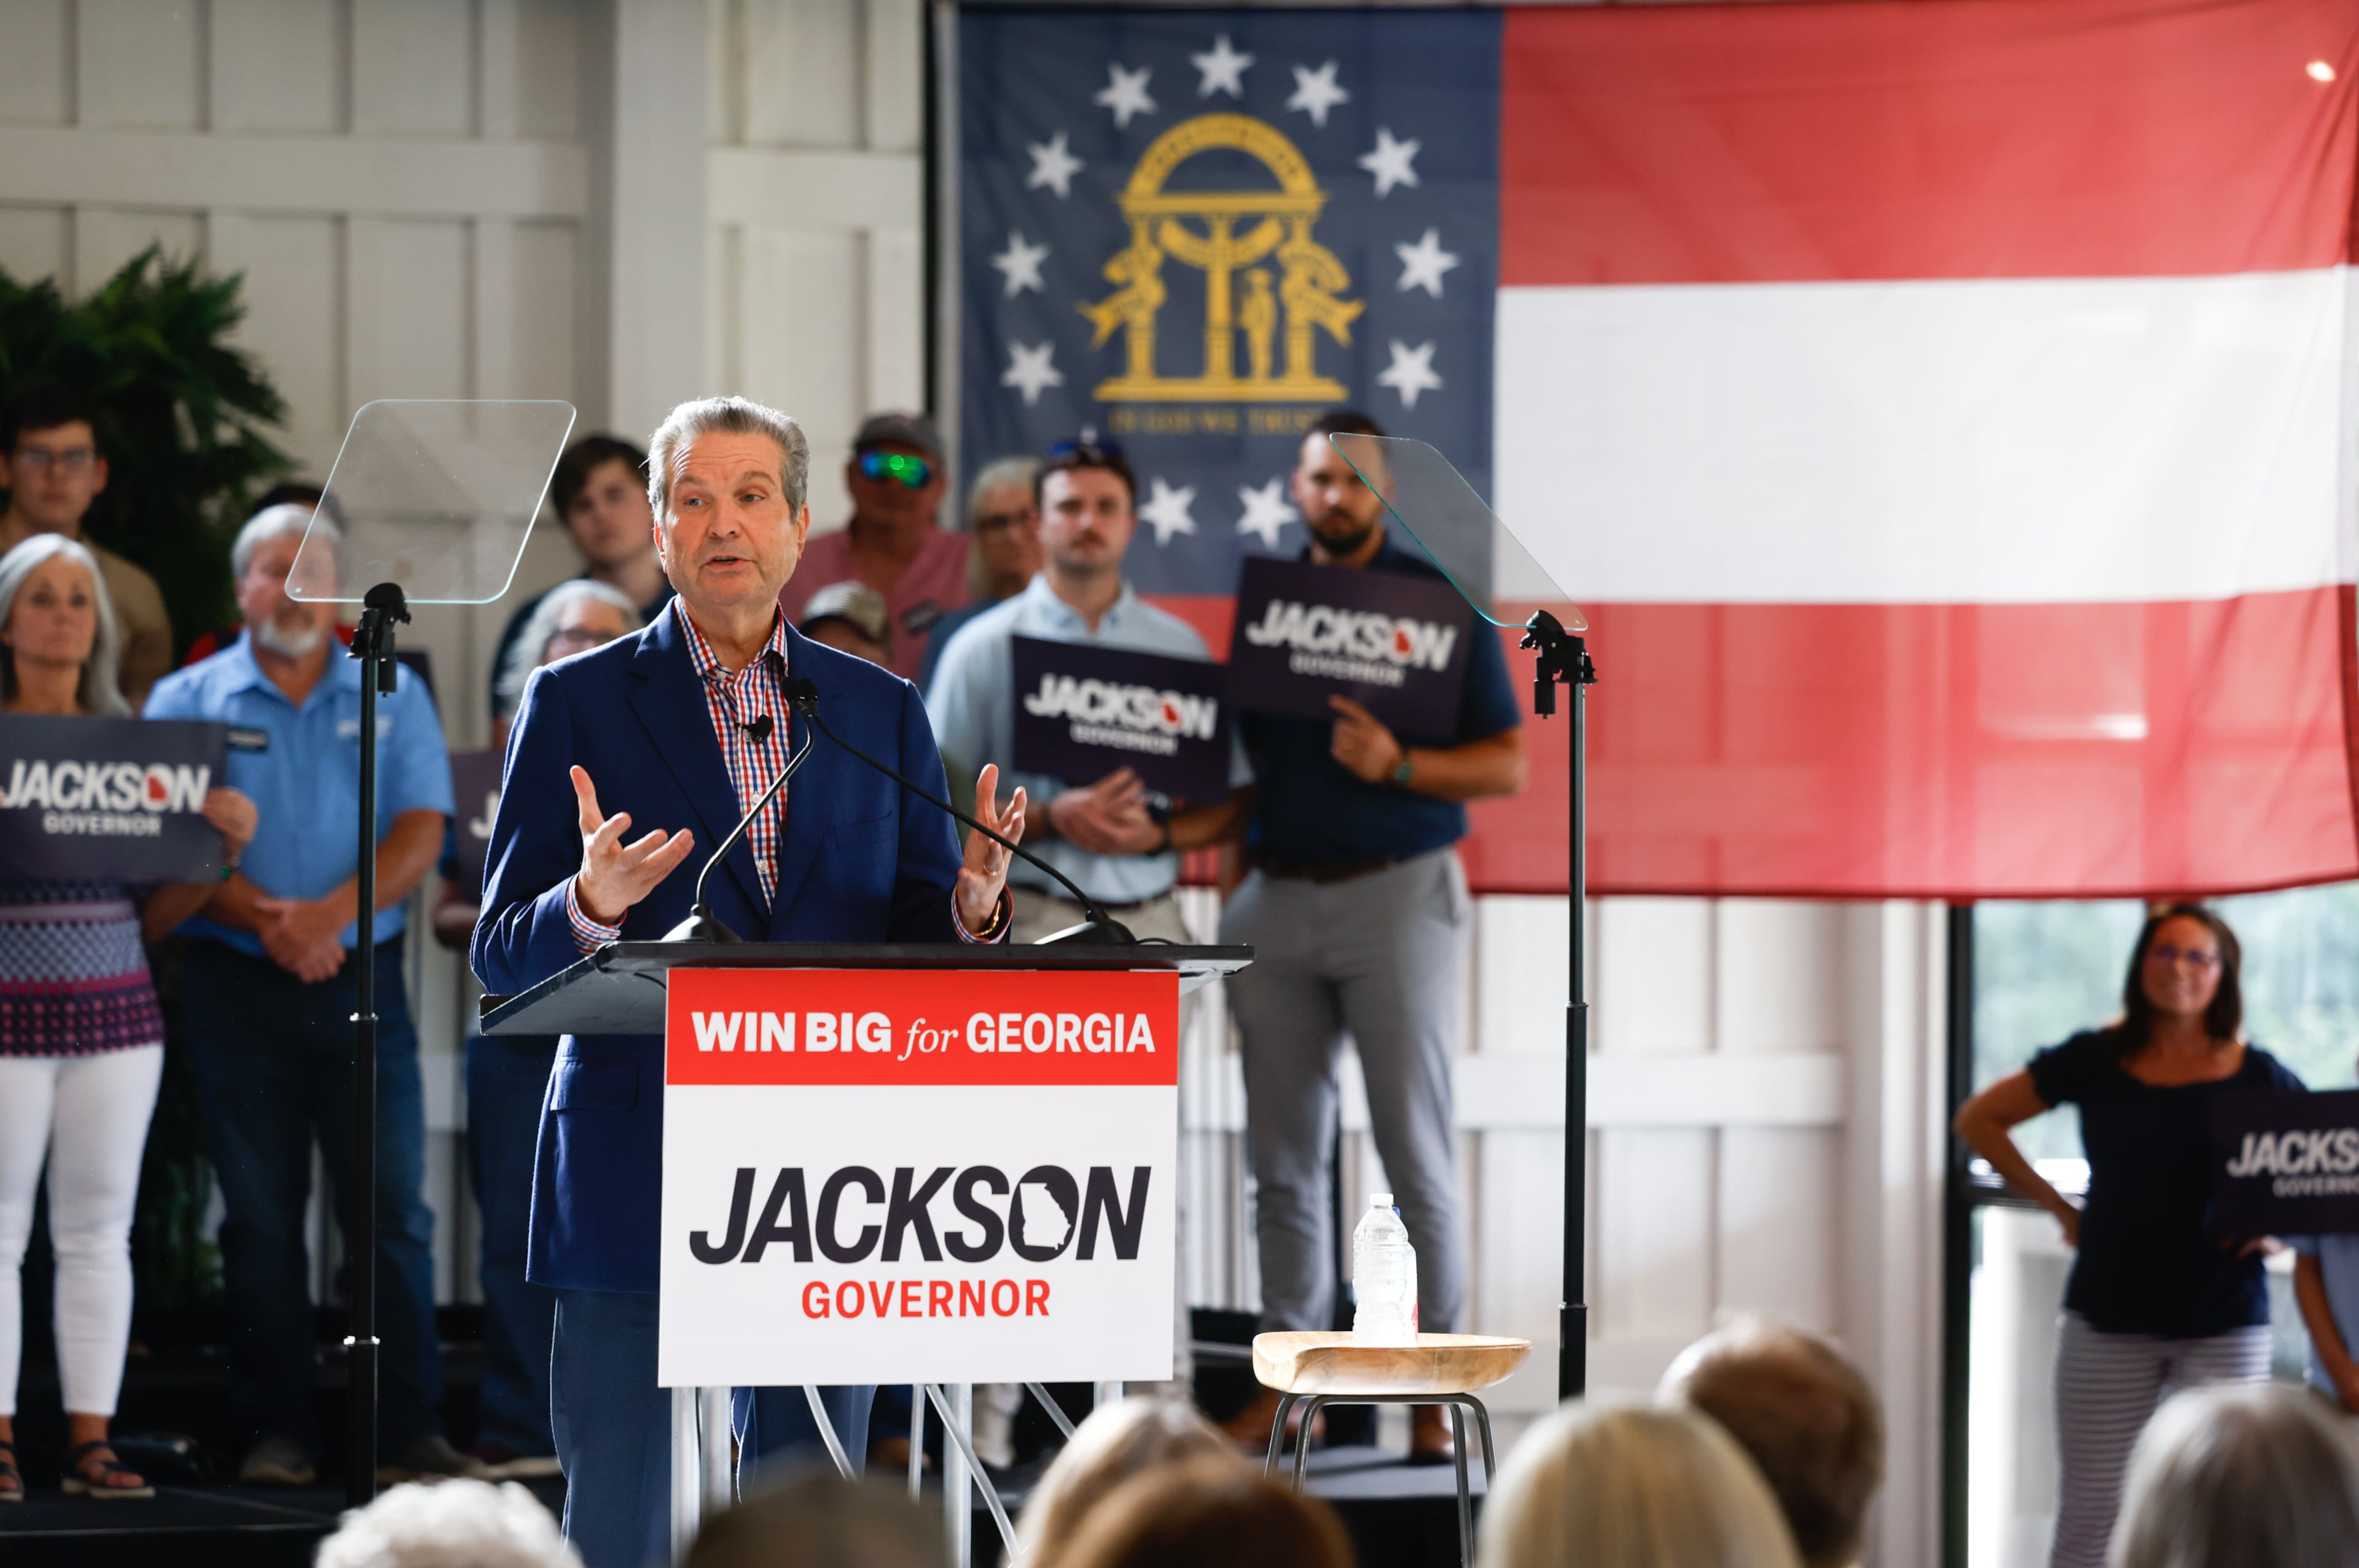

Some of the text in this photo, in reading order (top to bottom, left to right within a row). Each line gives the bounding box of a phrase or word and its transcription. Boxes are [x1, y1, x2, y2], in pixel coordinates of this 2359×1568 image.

[1245, 599, 1457, 673] JACKSON
[1024, 673, 1218, 741] JACKSON
[2, 760, 211, 814] JACKSON
[43, 811, 162, 836] GOVERNOR
[691, 1012, 1156, 1061] WIN BIG for GEORGIA
[689, 1165, 1152, 1265] JACKSON
[802, 1279, 1050, 1319] GOVERNOR
